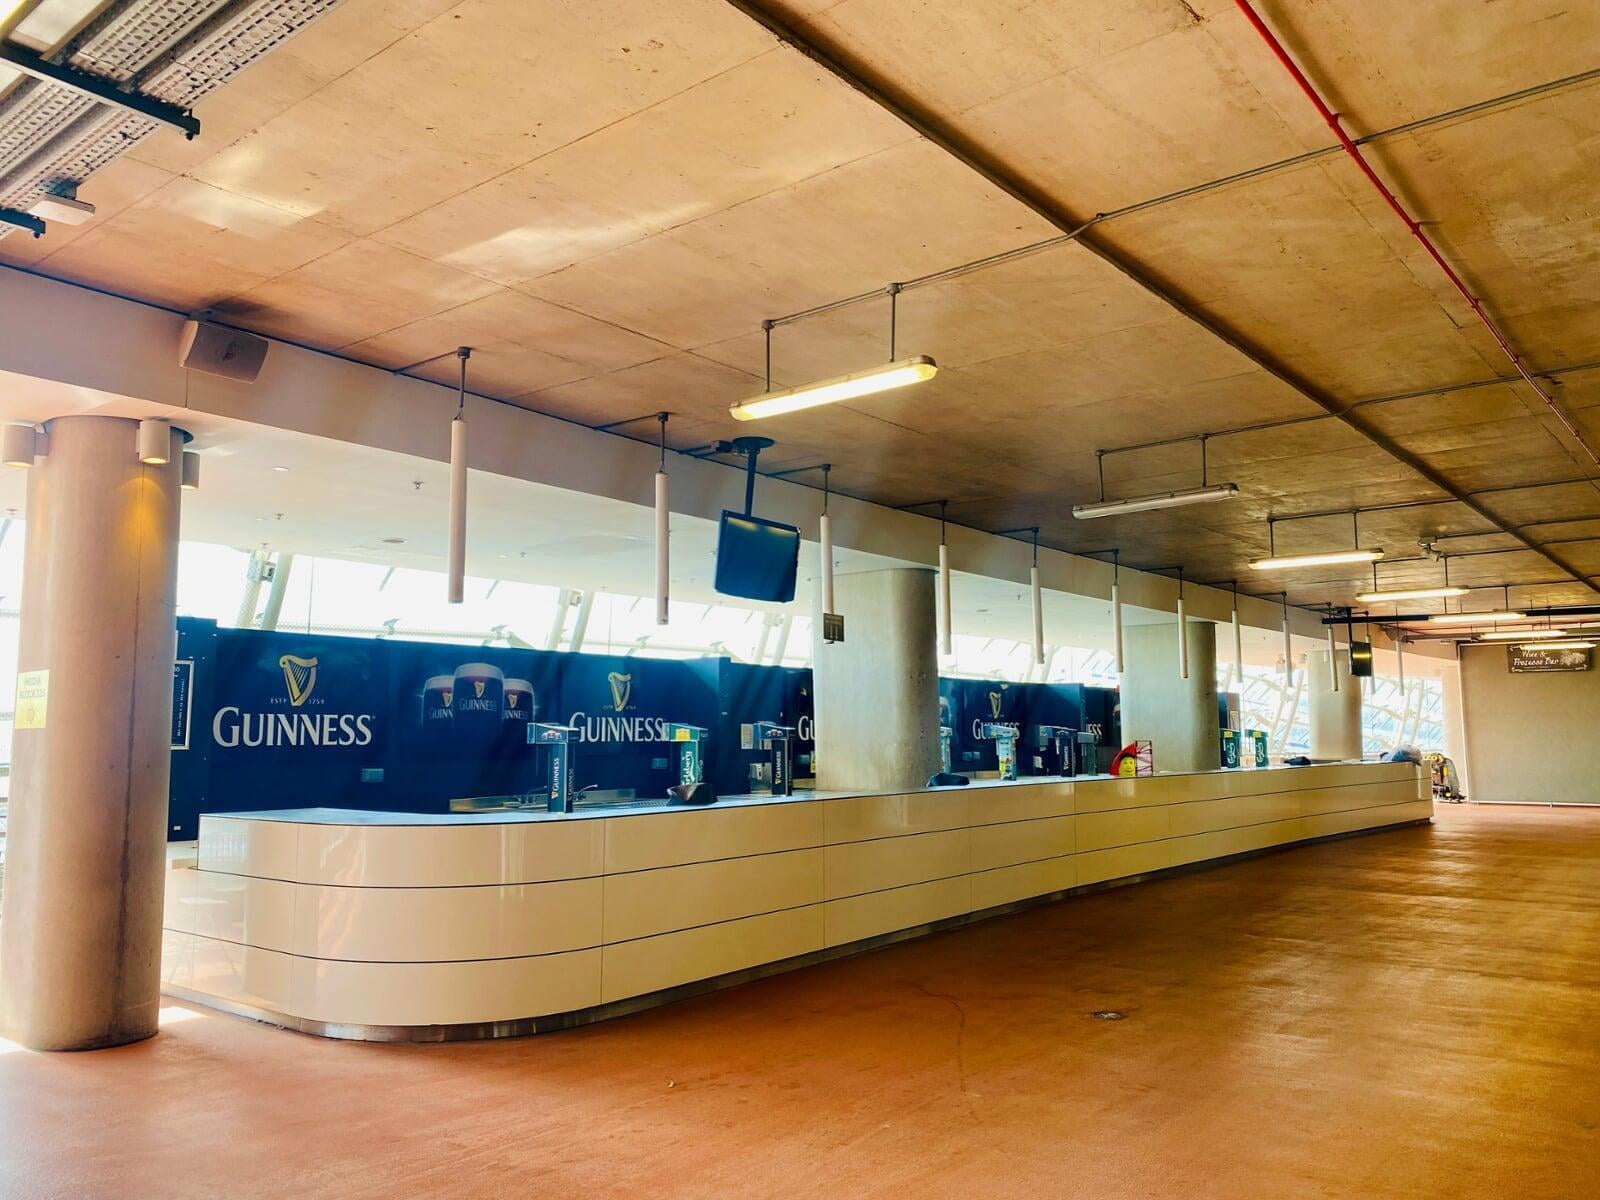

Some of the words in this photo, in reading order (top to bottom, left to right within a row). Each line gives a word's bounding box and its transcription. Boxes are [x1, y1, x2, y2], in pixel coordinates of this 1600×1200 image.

[458, 697, 497, 711] GUINNESS
[212, 706, 373, 747] GUINNESS
[568, 711, 664, 743] GUINNESS
[552, 757, 560, 791] GUINNESS
